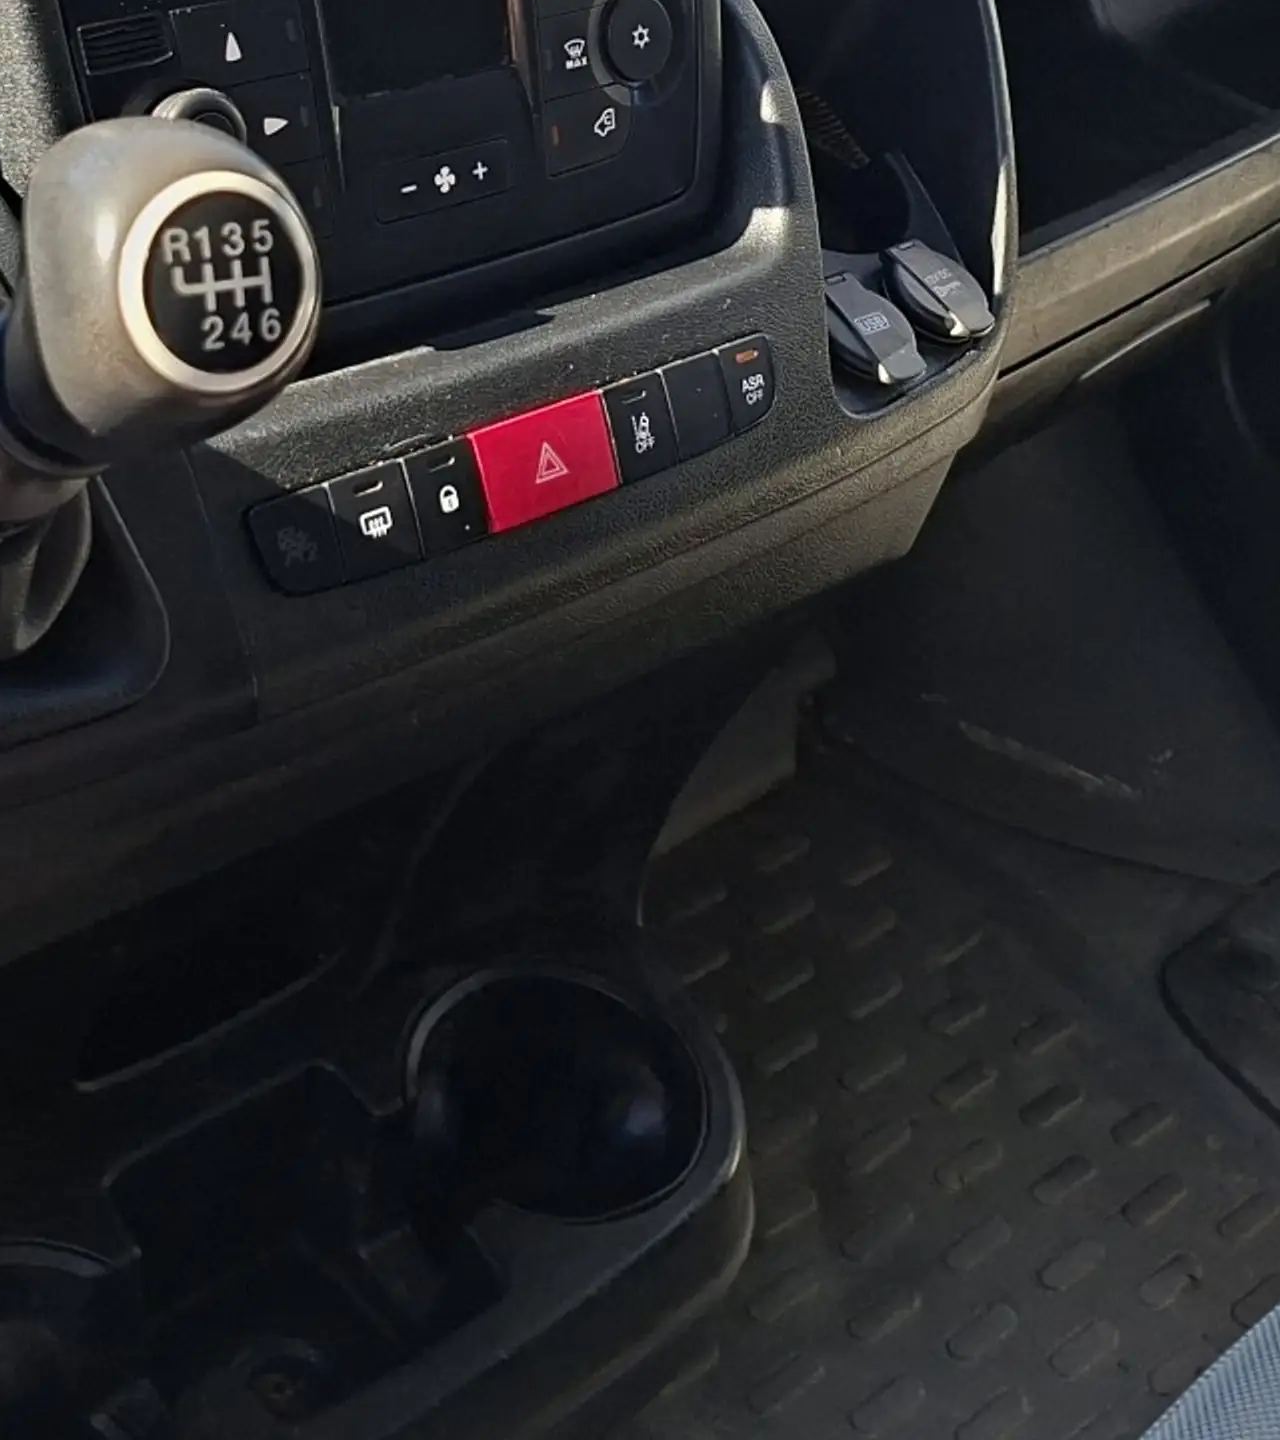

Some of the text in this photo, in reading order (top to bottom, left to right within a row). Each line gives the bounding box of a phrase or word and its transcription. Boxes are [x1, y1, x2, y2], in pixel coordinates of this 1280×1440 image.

[565, 56, 588, 70] MAX
[859, 315, 887, 330] USB
[741, 373, 766, 394] ASR
[745, 388, 764, 406] OFF
[635, 435, 656, 454] OFF
